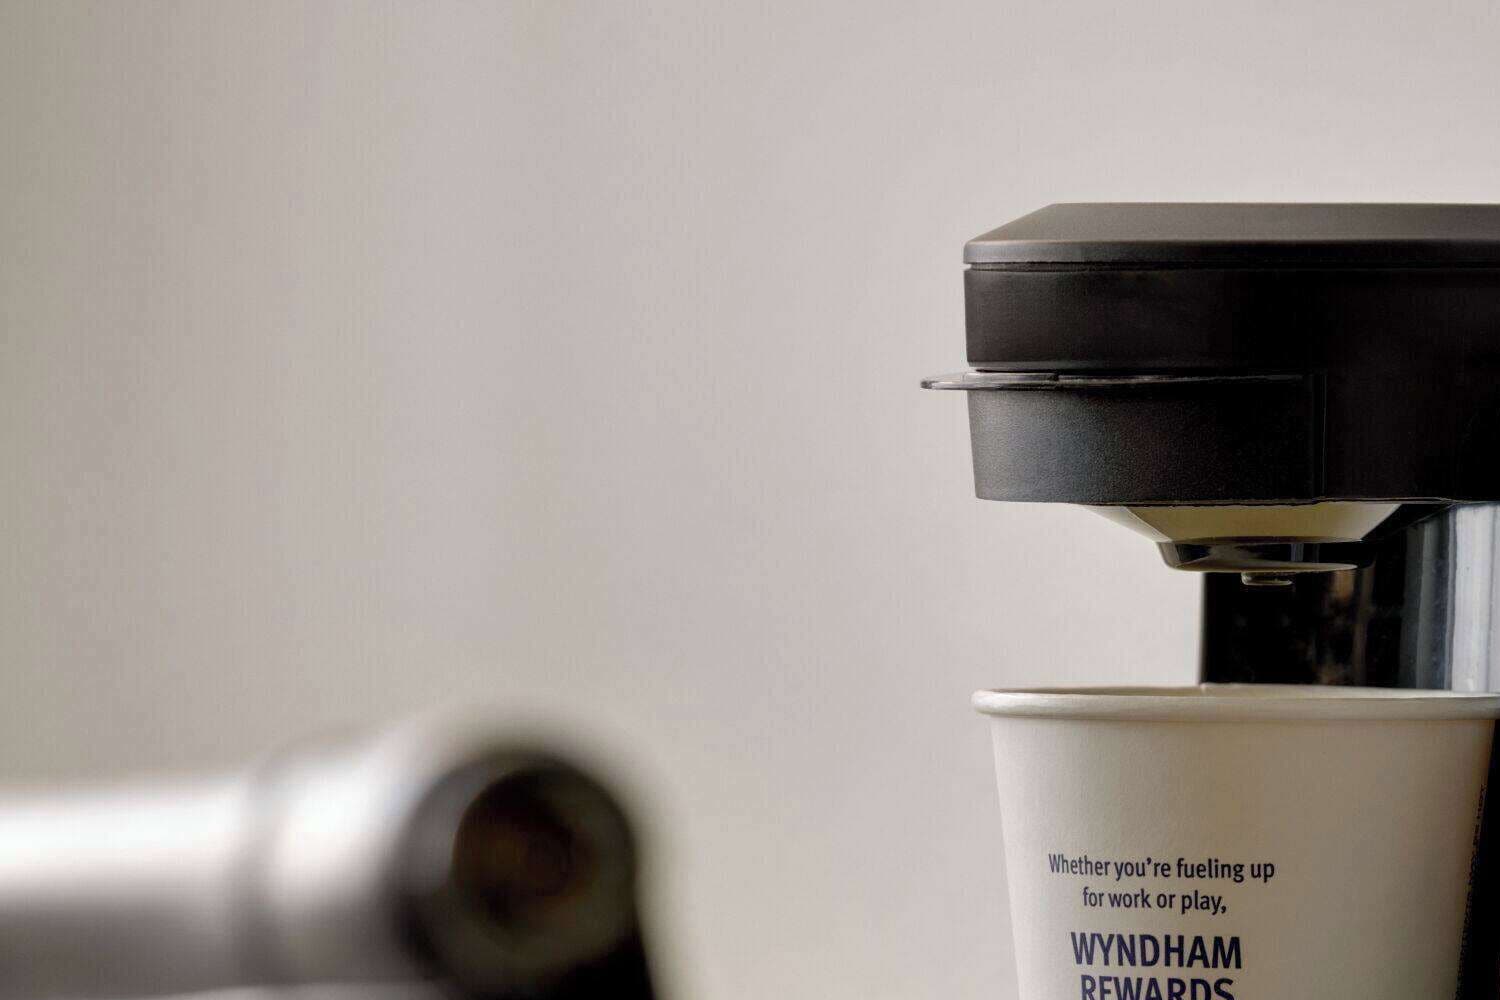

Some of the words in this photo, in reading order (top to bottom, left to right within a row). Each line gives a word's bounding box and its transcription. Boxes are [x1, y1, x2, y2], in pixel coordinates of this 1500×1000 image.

[1049, 854, 1110, 876] Whether
[1177, 858, 1244, 883] fueling
[1250, 863, 1275, 882] up
[1083, 887, 1104, 907] for
[1108, 889, 1151, 908] work
[1156, 894, 1176, 908] or
[1181, 890, 1227, 915] play,
[1071, 932, 1242, 969] WYNDHAM
